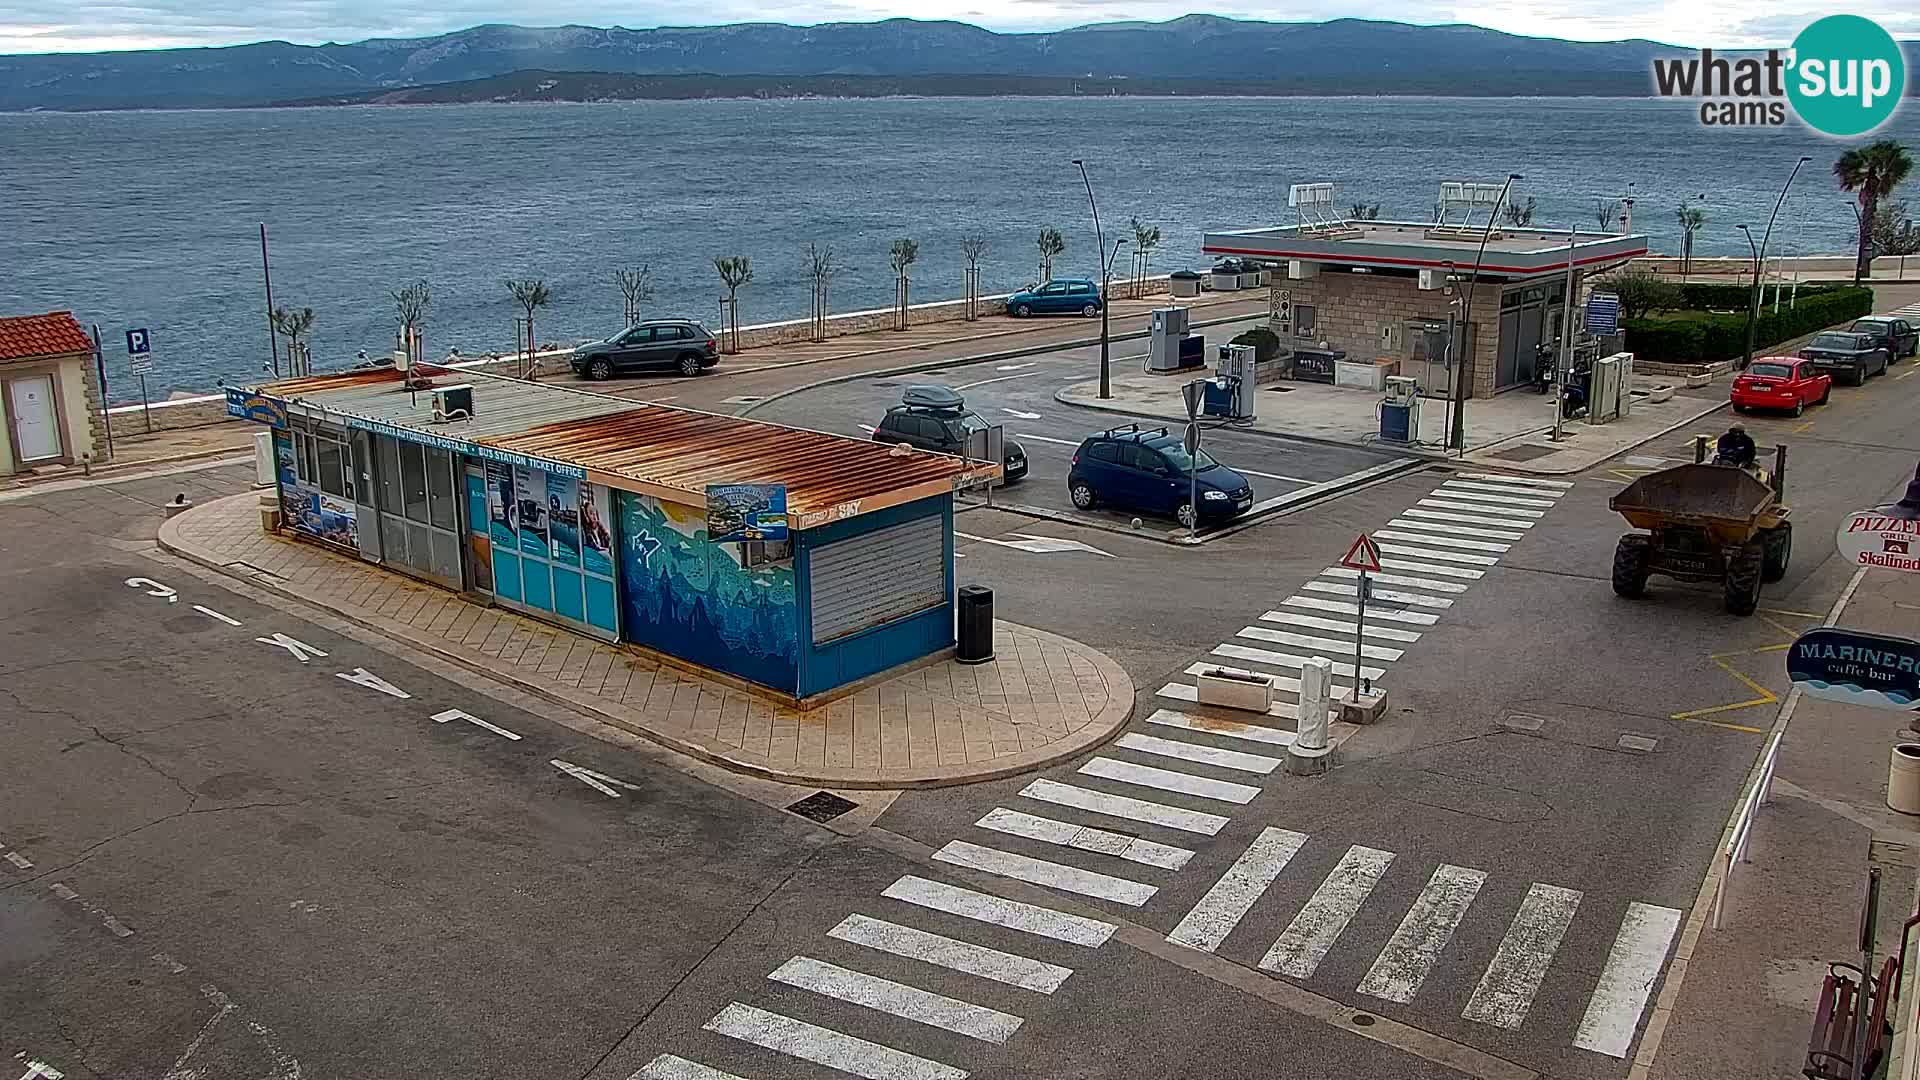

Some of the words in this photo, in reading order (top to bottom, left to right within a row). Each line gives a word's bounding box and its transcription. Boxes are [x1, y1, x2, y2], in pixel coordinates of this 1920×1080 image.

[131, 332, 144, 351] P
[437, 438, 469, 453] POSTAJA
[478, 447, 494, 459] BUS
[495, 450, 527, 466] STATION
[528, 458, 555, 473] TICKET
[555, 465, 583, 478] OFFICE
[1880, 532, 1915, 542] GRILL
[1827, 663, 1865, 676] caffe
[1869, 667, 1896, 681] bar
